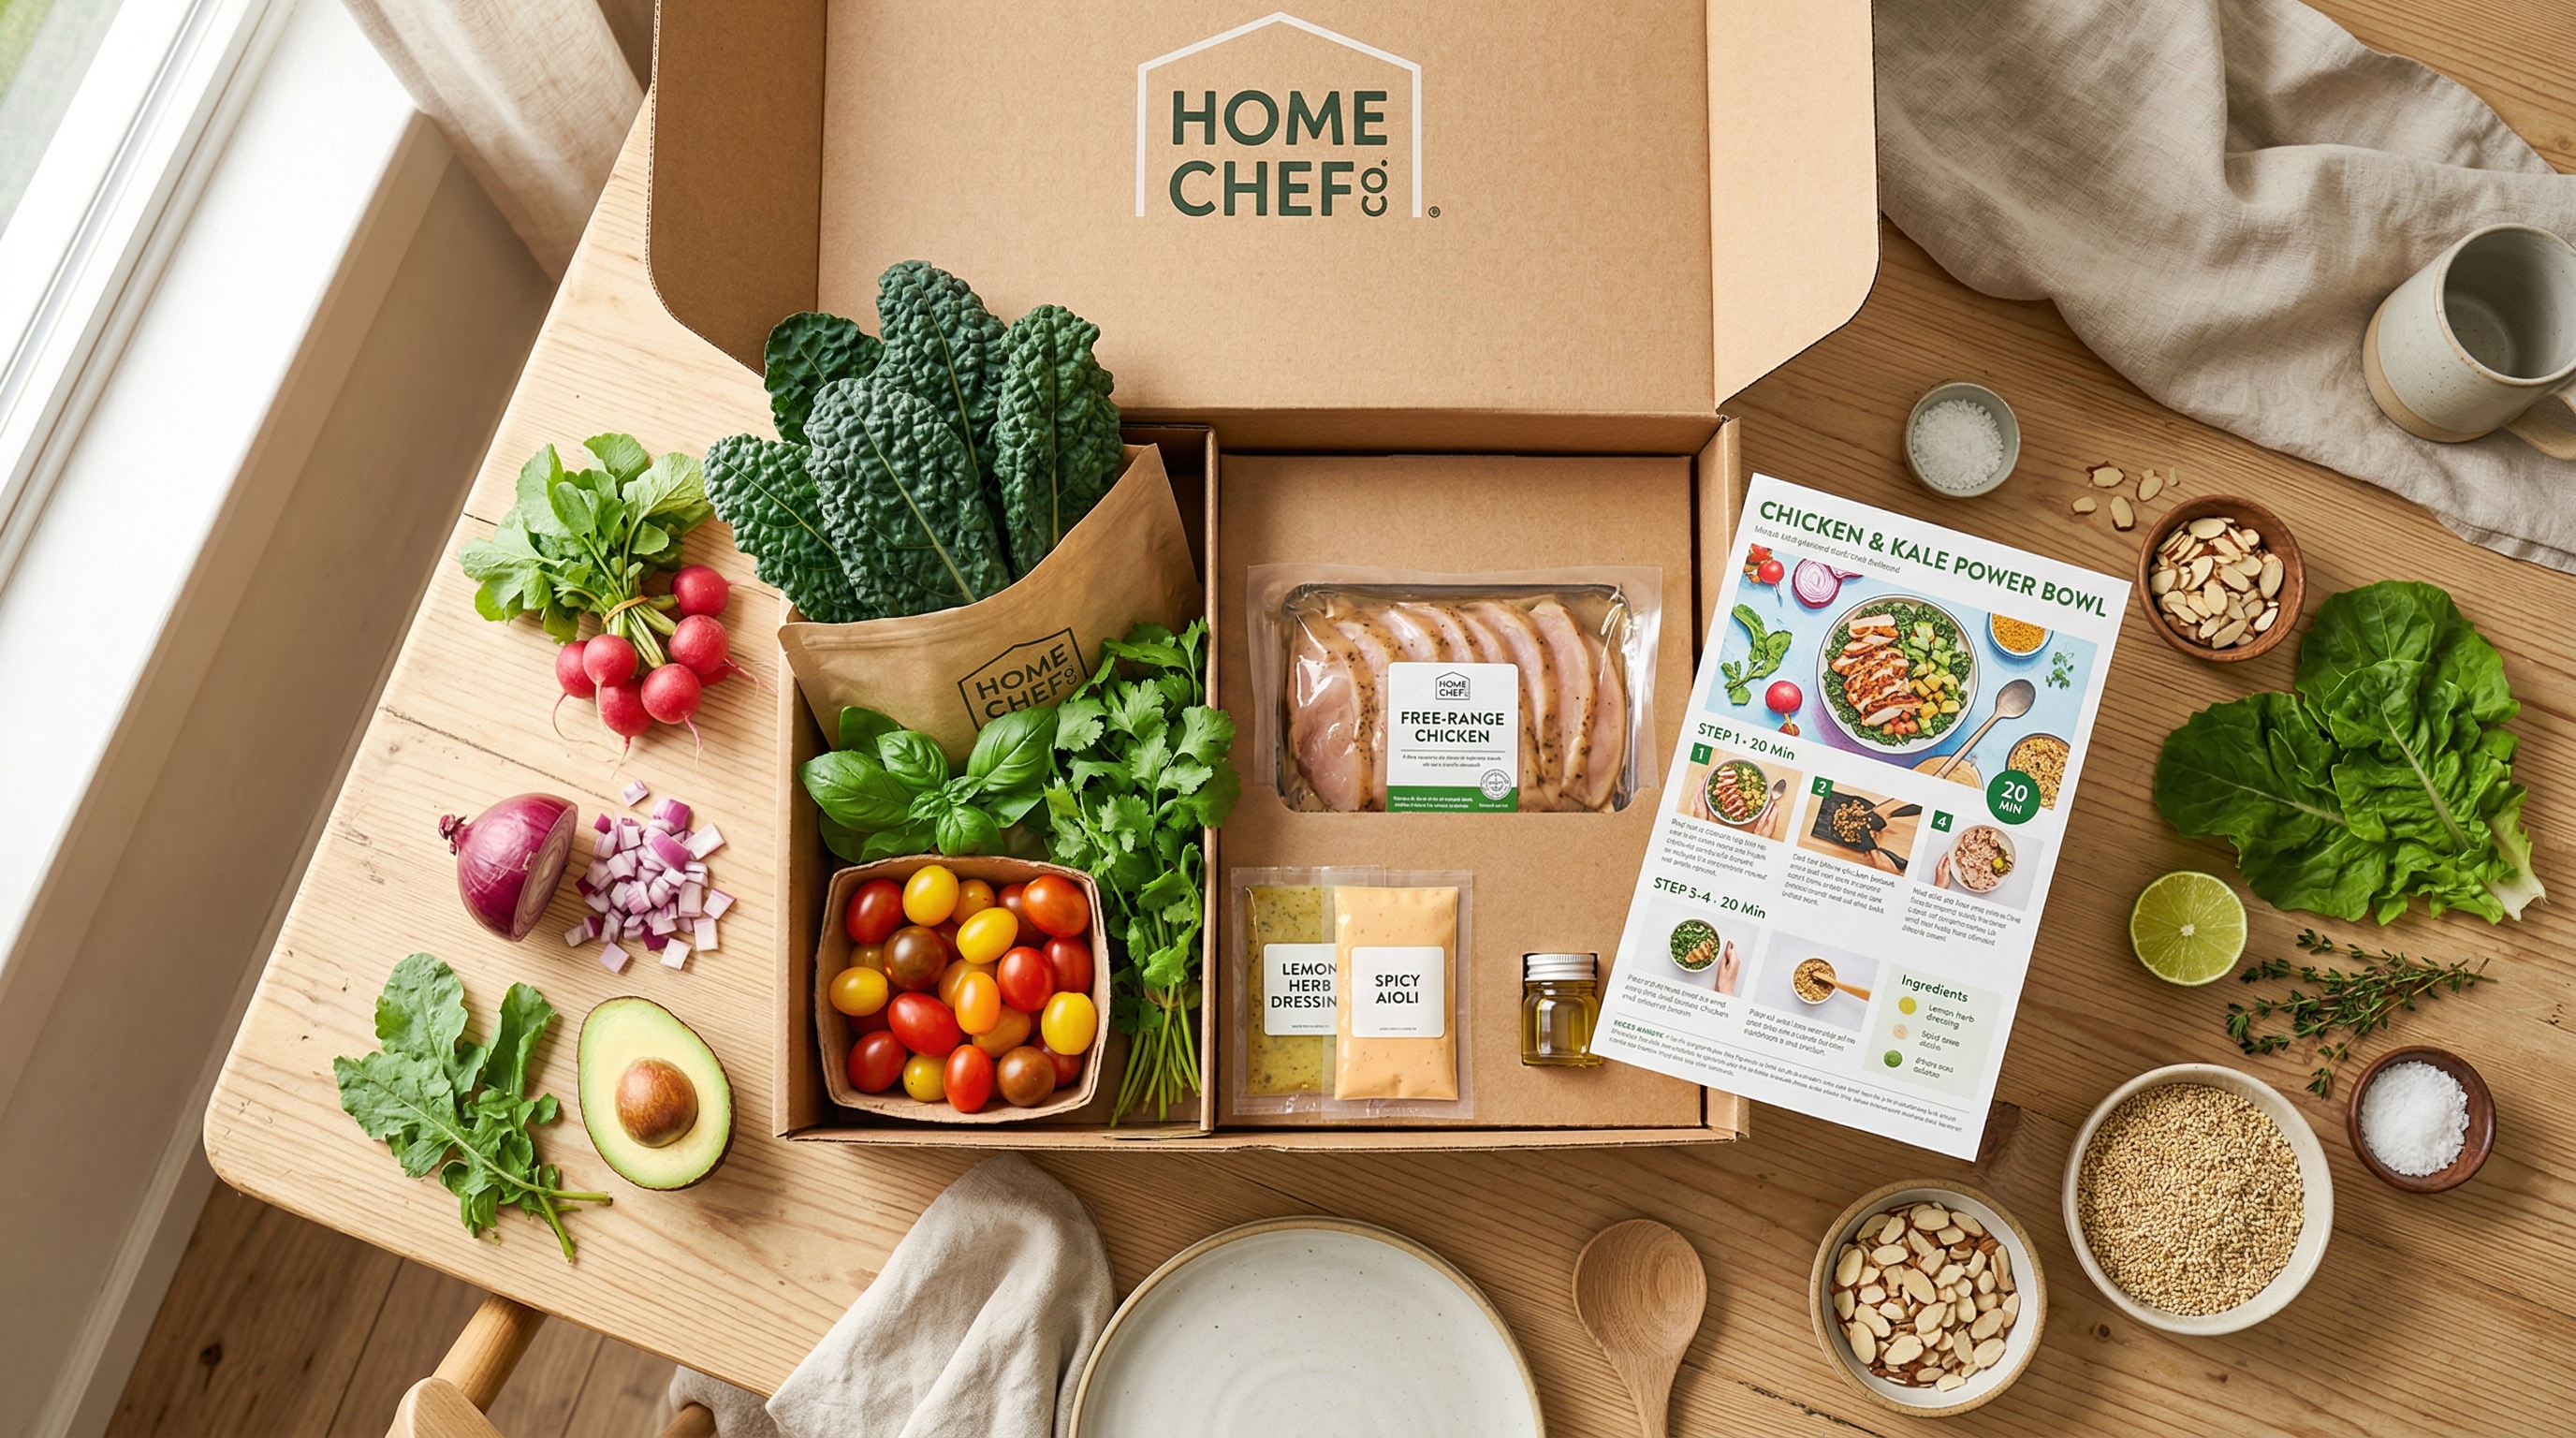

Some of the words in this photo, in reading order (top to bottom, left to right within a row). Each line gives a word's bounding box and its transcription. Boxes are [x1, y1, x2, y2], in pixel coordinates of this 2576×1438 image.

[1173, 90, 1387, 146] HOME
[1169, 160, 1354, 217] CHEF
[1761, 502, 1864, 545] CHICKEN
[1867, 531, 1885, 553] &
[1891, 537, 1949, 570] KALE
[1954, 556, 2036, 595] POWER
[2042, 581, 2106, 617] BOWL
[975, 643, 1068, 699] HOME
[985, 671, 1062, 719] CHEF
[1400, 712, 1504, 726] FREE-RANGE
[1414, 729, 1490, 742] CHICKEN
[1698, 723, 1732, 741] STEP
[1734, 732, 1740, 745] 1
[1749, 737, 1768, 753] 20
[1769, 742, 1795, 761] Min
[1698, 747, 1705, 760] 1
[1817, 780, 1827, 794] 2
[2000, 780, 2028, 802] 20
[1998, 800, 2023, 814] MIN
[1937, 815, 1947, 828] 4
[1654, 877, 1687, 894] STEP
[1720, 896, 1739, 911] 20
[1740, 902, 1766, 919] Min
[1289, 979, 1331, 992] HERB
[1375, 974, 1420, 988] SPICY
[1902, 975, 1968, 1002] Ingredients
[1271, 995, 1337, 1008] DRESSIN
[1375, 990, 1419, 1004] AIOLI
